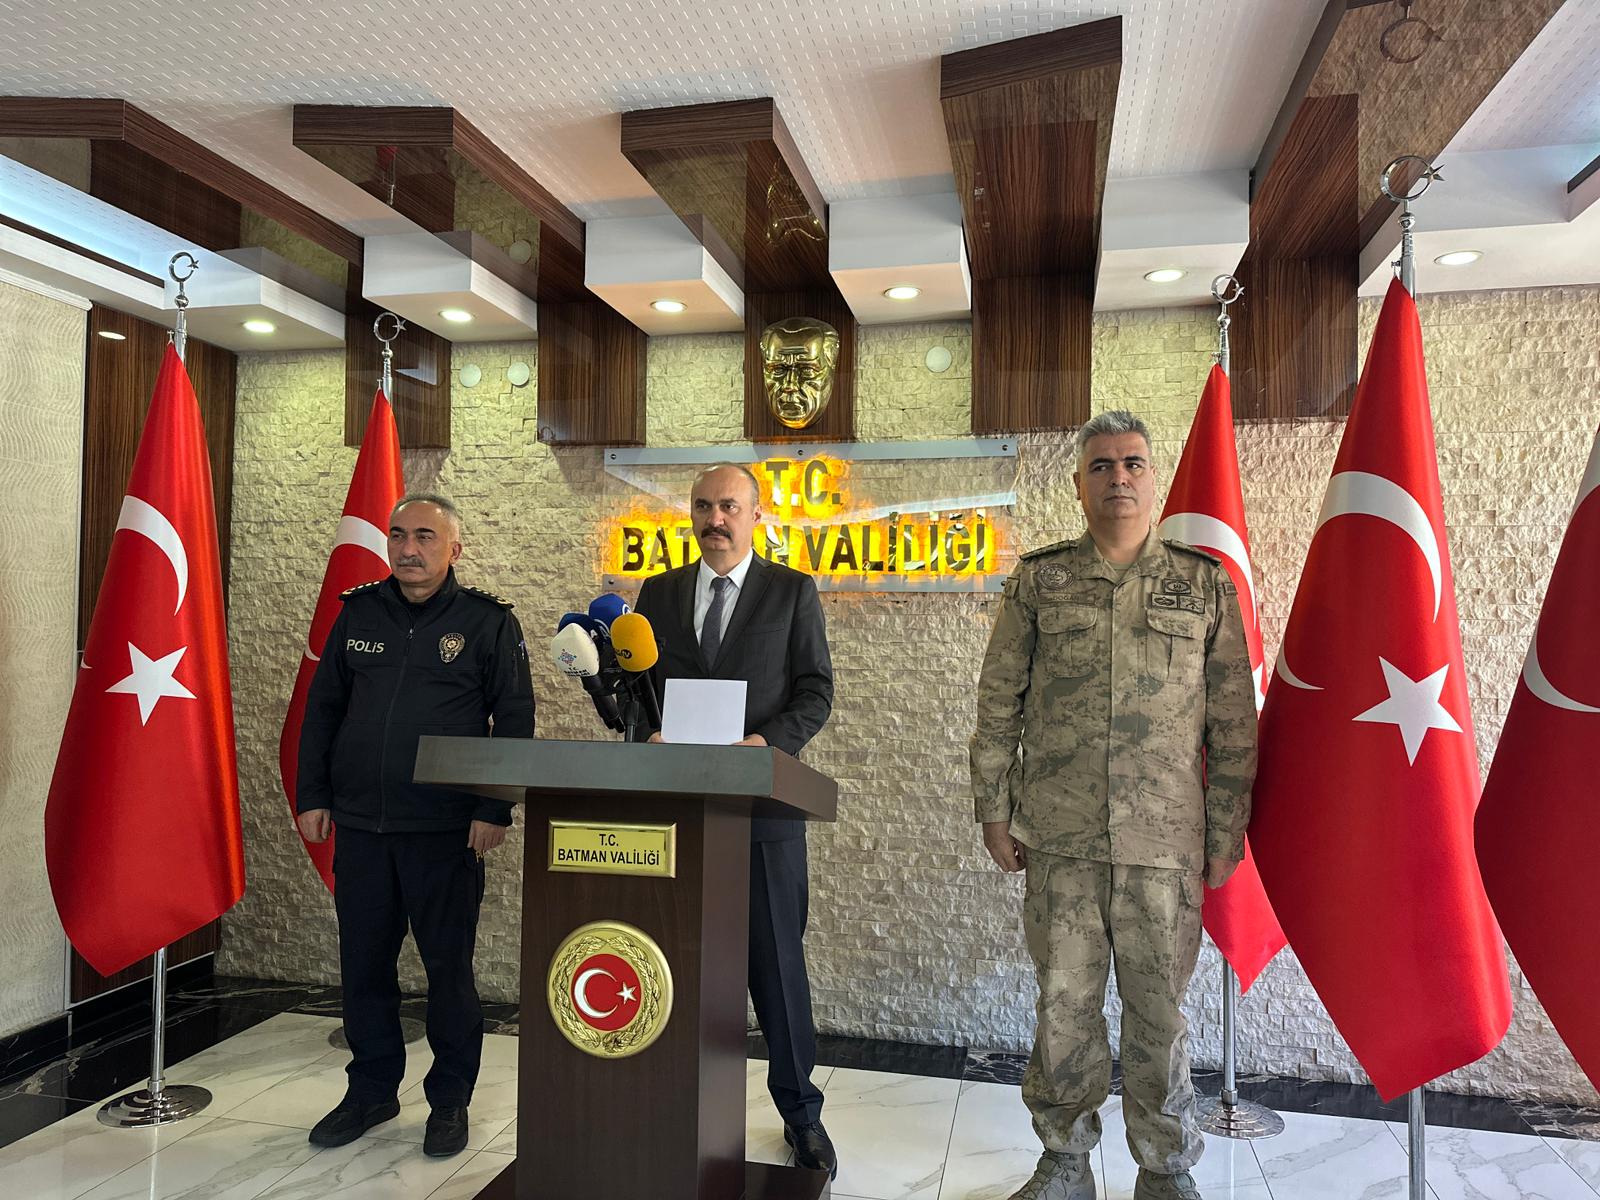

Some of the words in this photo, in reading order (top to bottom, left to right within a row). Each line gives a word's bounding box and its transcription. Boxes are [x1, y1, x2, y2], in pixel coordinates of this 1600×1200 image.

[766, 460, 841, 506] T.C.
[622, 525, 790, 571] BATN
[802, 508, 986, 572] VALİLİĞİ
[599, 833, 619, 847] T.C.
[558, 848, 607, 863] BATMAN
[610, 849, 660, 866] VALİLİĞİ
